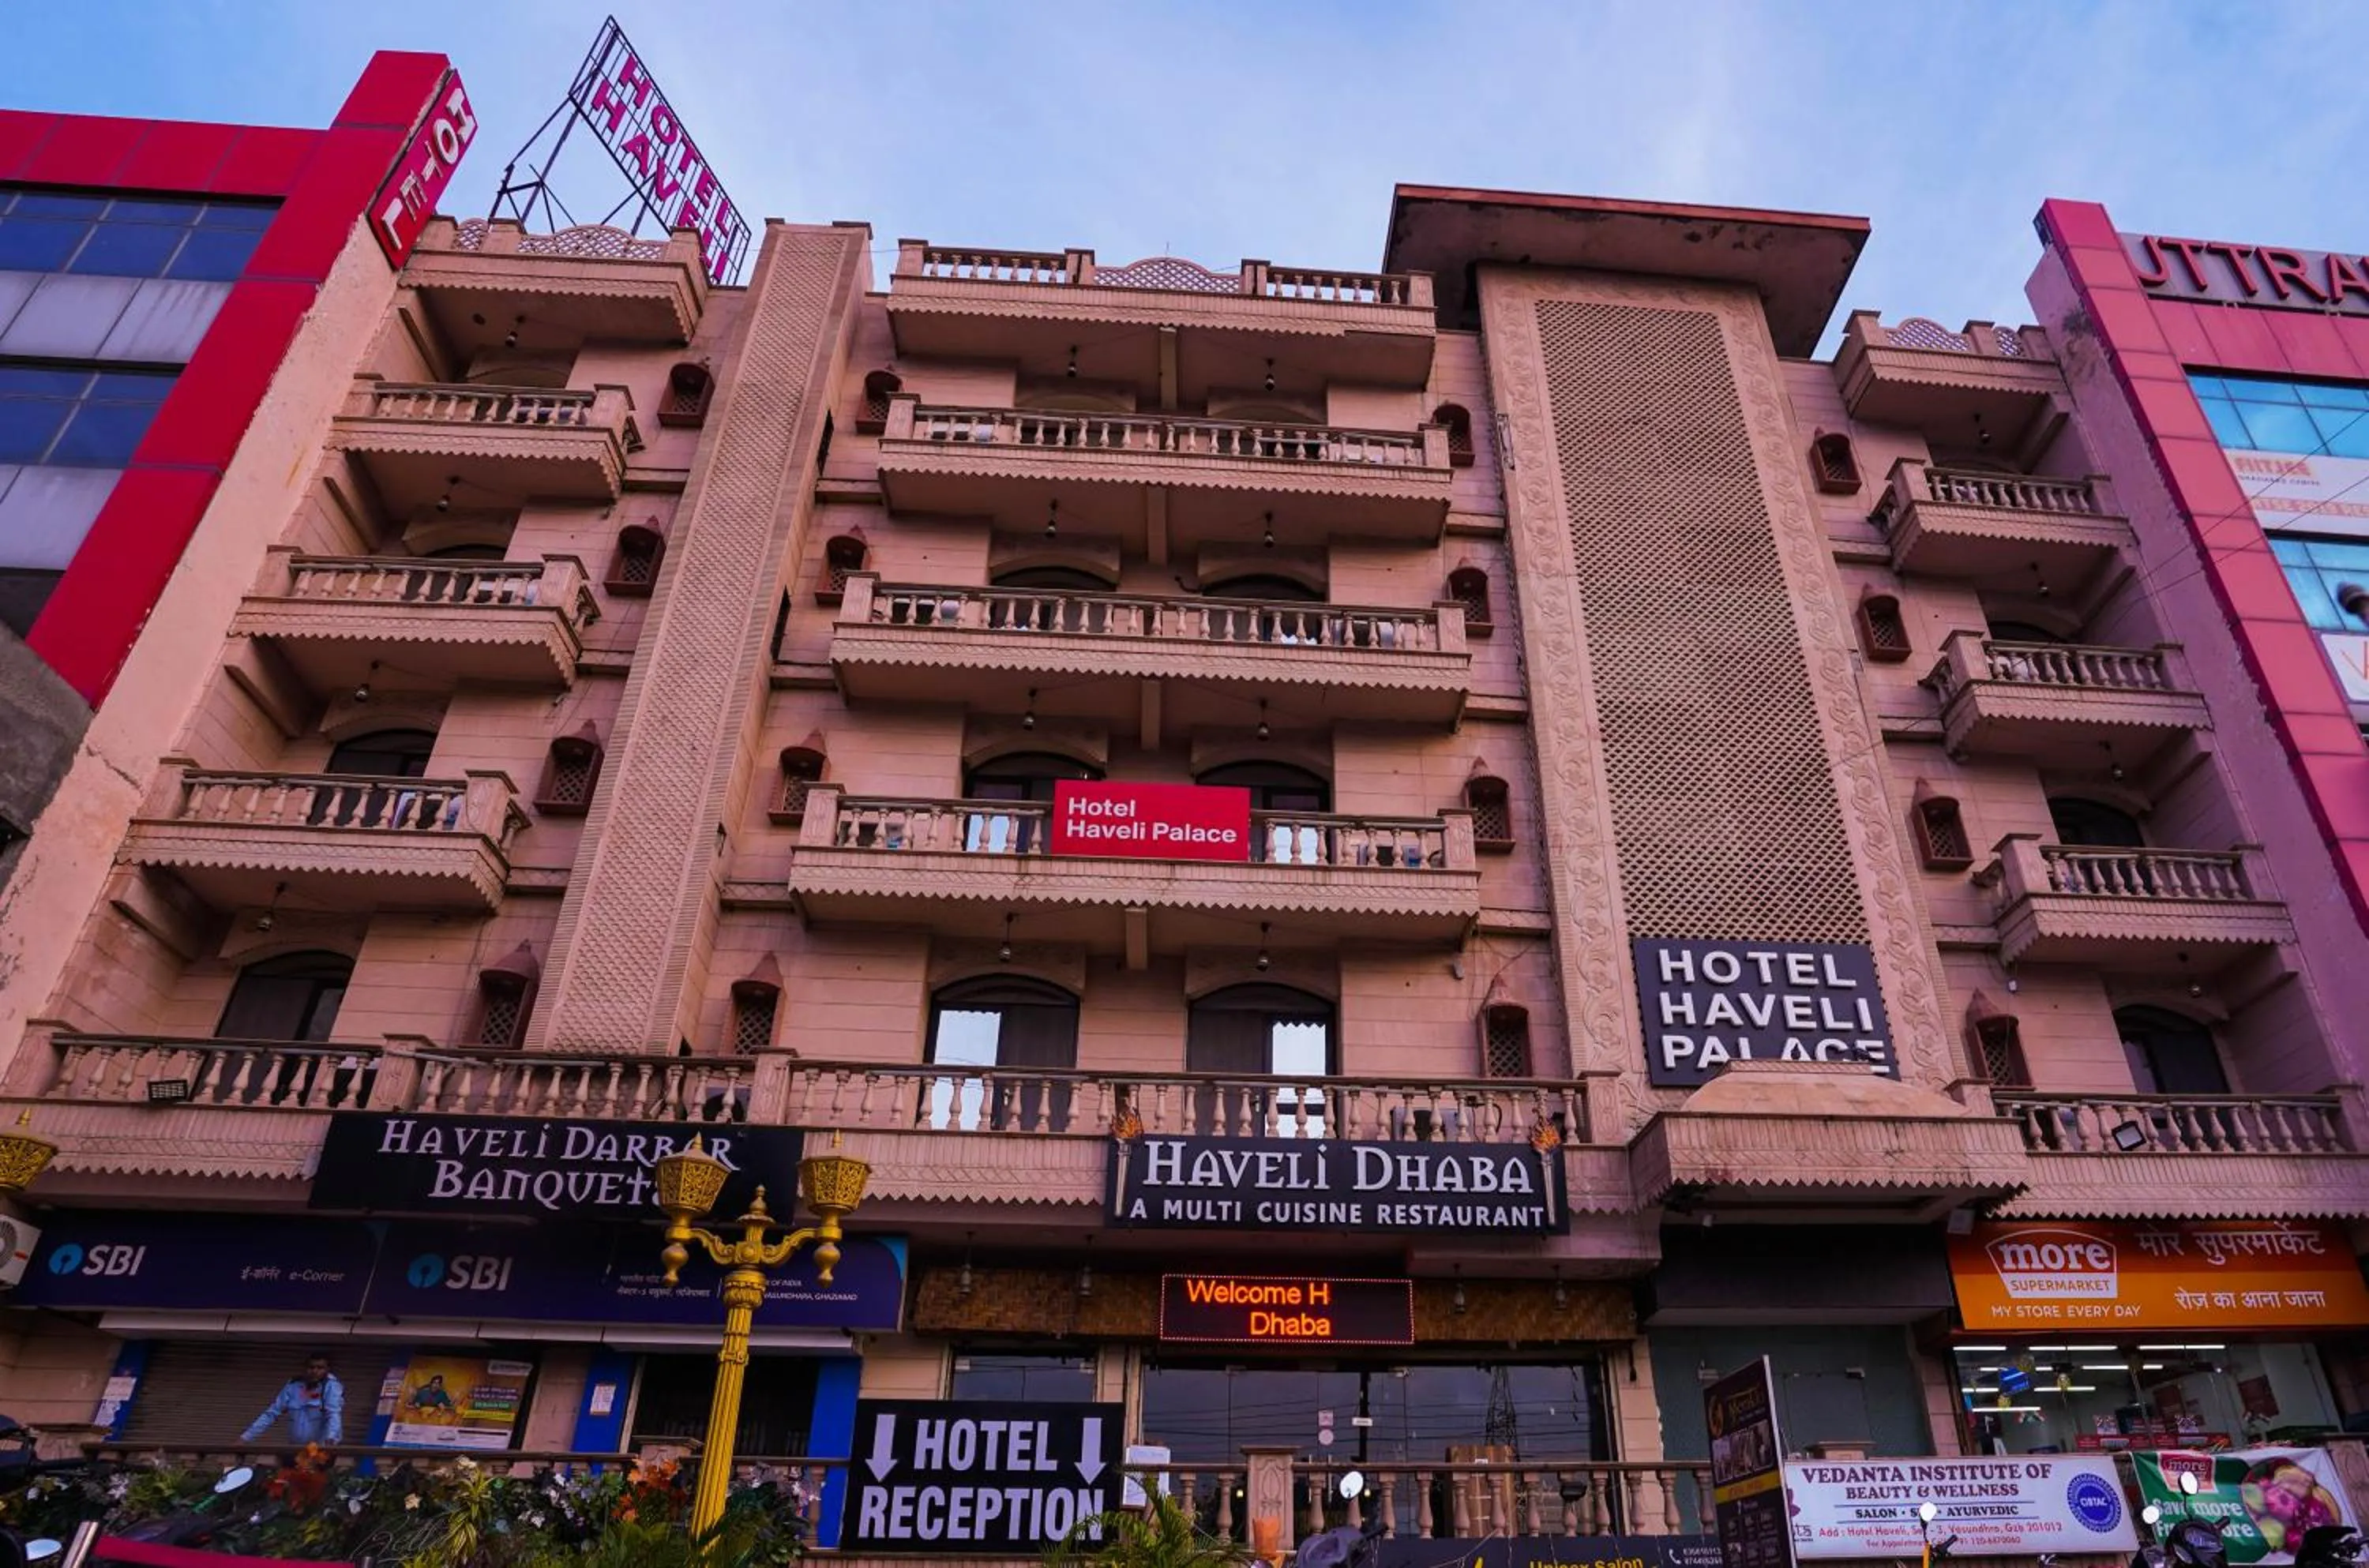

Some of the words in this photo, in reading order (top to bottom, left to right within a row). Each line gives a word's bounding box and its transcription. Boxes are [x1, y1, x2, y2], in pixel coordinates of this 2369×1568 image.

[620, 52, 731, 238] HOTEL
[381, 88, 475, 250] HOTEL
[2135, 235, 2369, 304] UTTRA
[1068, 797, 1136, 817] Hotel
[1067, 820, 1146, 840] Haveli
[1152, 822, 1238, 842] Palace
[1659, 948, 1857, 987] HOTEL
[1659, 992, 1874, 1032] HAVELI
[1353, 1146, 1534, 1194] DHABA
[428, 1160, 660, 1210] BANQUET
[1130, 1200, 1148, 1220] A
[1164, 1199, 1241, 1222] MULTI
[1257, 1202, 1361, 1225] CUISINE
[1377, 1204, 1545, 1228] RESTAURANT
[2134, 1225, 2184, 1257] मोर
[81, 1245, 147, 1277] SBI
[2000, 1239, 2111, 1272] more
[289, 1268, 346, 1282] e-Corner
[445, 1255, 513, 1292] SBI
[2010, 1279, 2110, 1292] SUPERMARKET
[1187, 1280, 1301, 1304] Welcome
[1309, 1282, 1329, 1305] H
[2212, 1291, 2236, 1308] का
[2241, 1291, 2282, 1309] आना
[2284, 1291, 2326, 1309] जाना
[1249, 1311, 1331, 1336] Dhaba
[1992, 1306, 2012, 1319] MY
[2016, 1305, 2061, 1319] STORE
[2067, 1304, 2110, 1319] EVERY
[2114, 1304, 2142, 1318] DAY
[914, 1418, 1058, 1472] HOTEL
[1801, 1467, 1904, 1484] VEDANTA
[1910, 1465, 2023, 1484] INSTITUTE
[2026, 1463, 2053, 1480] OF
[2168, 1458, 2206, 1471] more
[1845, 1486, 1913, 1500] BEAUTY
[1917, 1485, 1930, 1499] &
[1932, 1484, 2020, 1498] WELLNESS
[858, 1485, 1104, 1541] RECEPTION
[1855, 1508, 1897, 1519] SALON
[1947, 1506, 2019, 1518] AYURVEDIC
[2194, 1502, 2244, 1517] more
[1847, 1526, 1872, 1536] Hotel
[2221, 1521, 2255, 1538] ore
